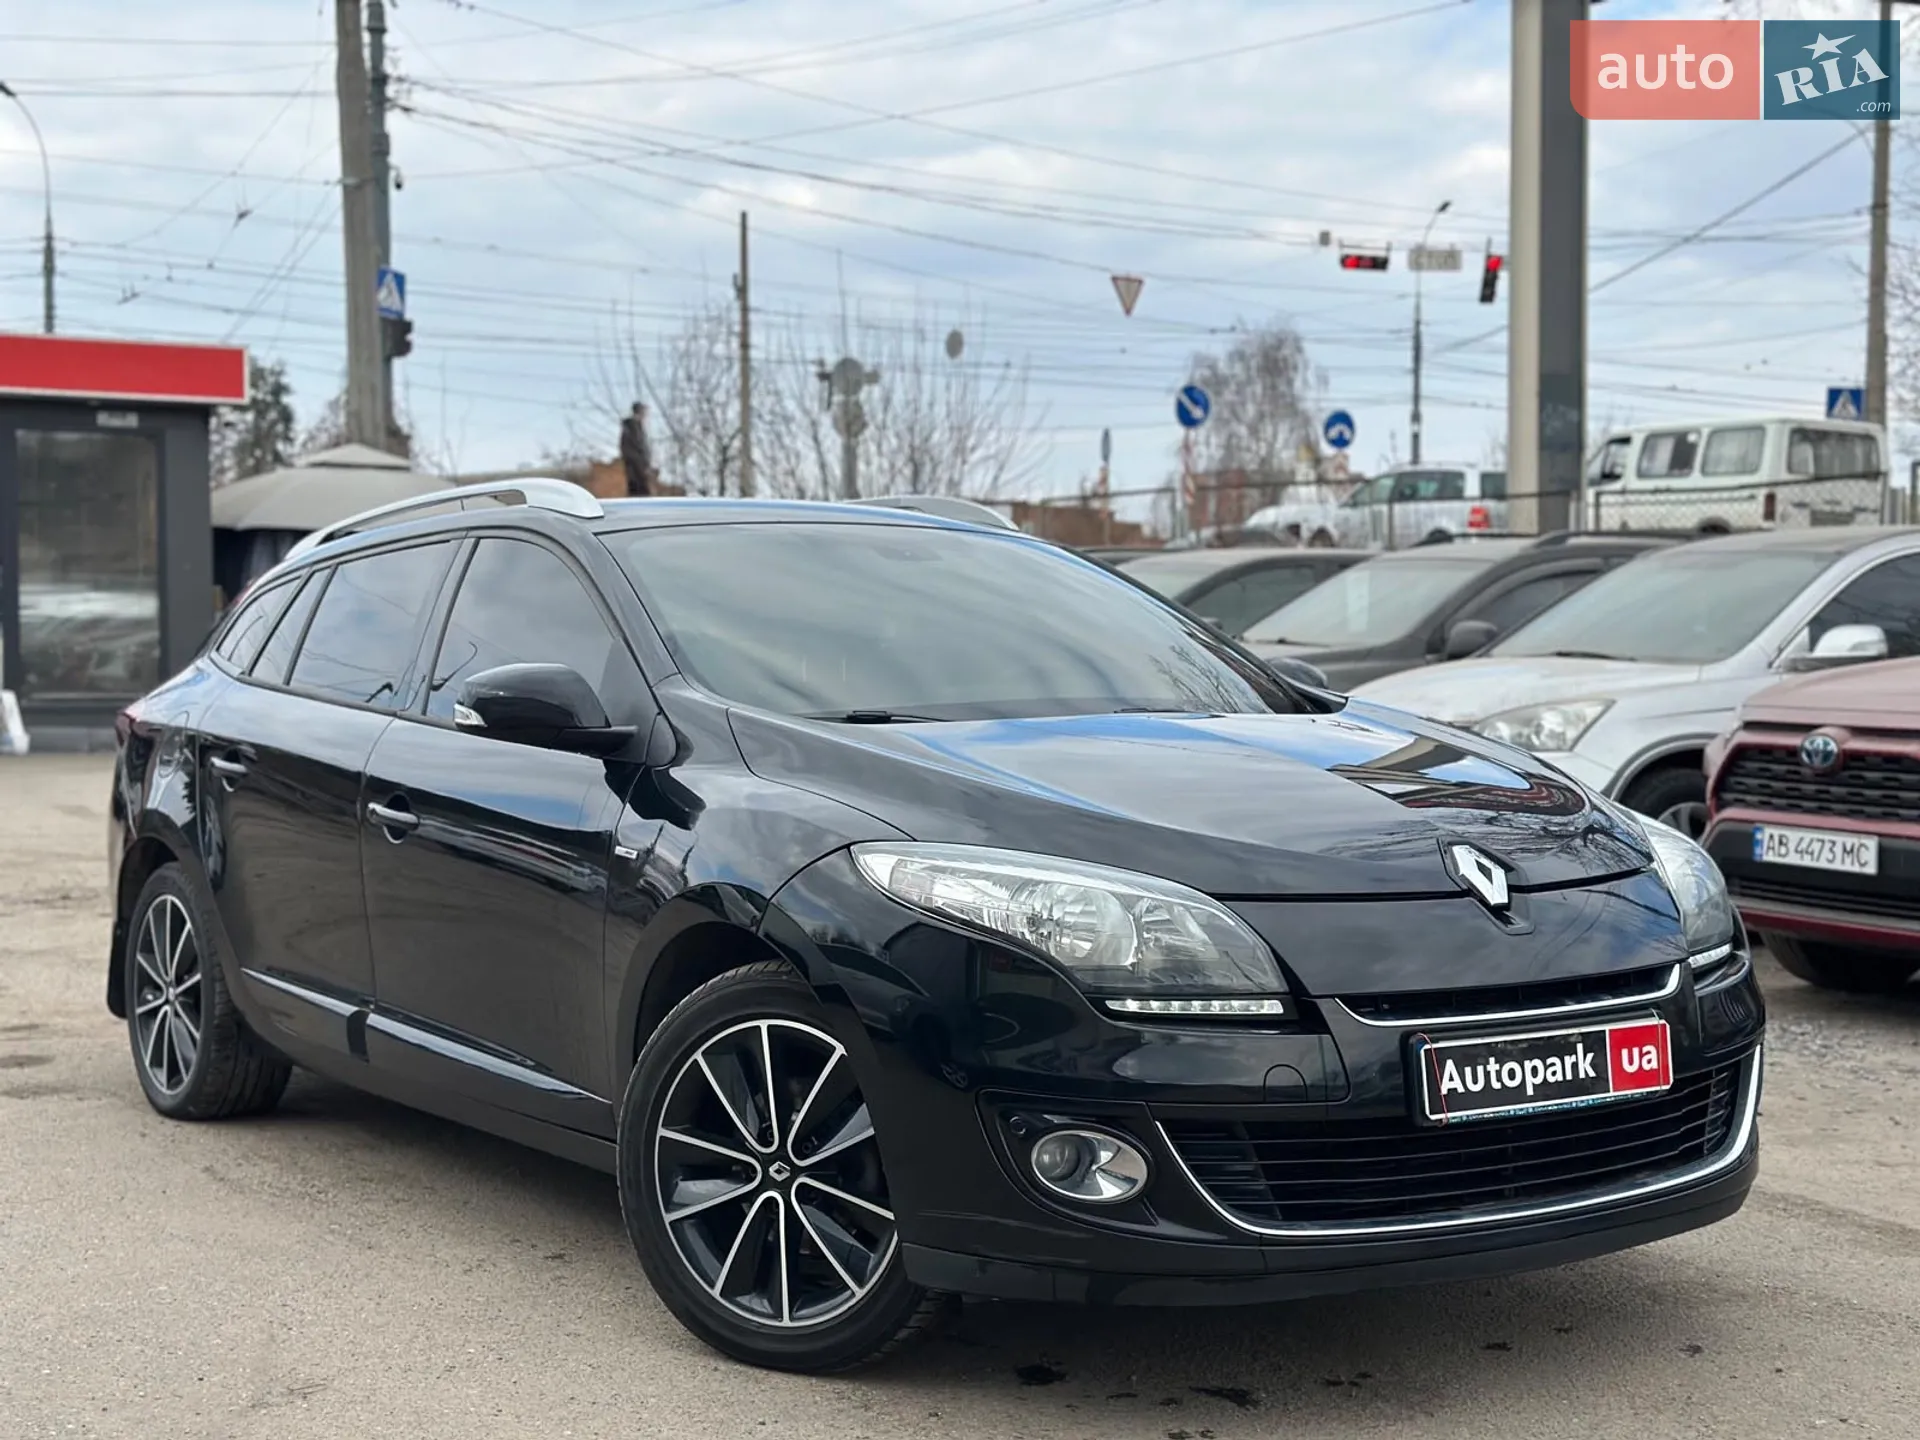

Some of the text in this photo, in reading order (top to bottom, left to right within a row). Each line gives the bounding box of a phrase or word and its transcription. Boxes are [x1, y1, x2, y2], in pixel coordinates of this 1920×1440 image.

[1766, 833, 1870, 867] AB 4473 MC
[1441, 1043, 1659, 1096] Autopark ua
